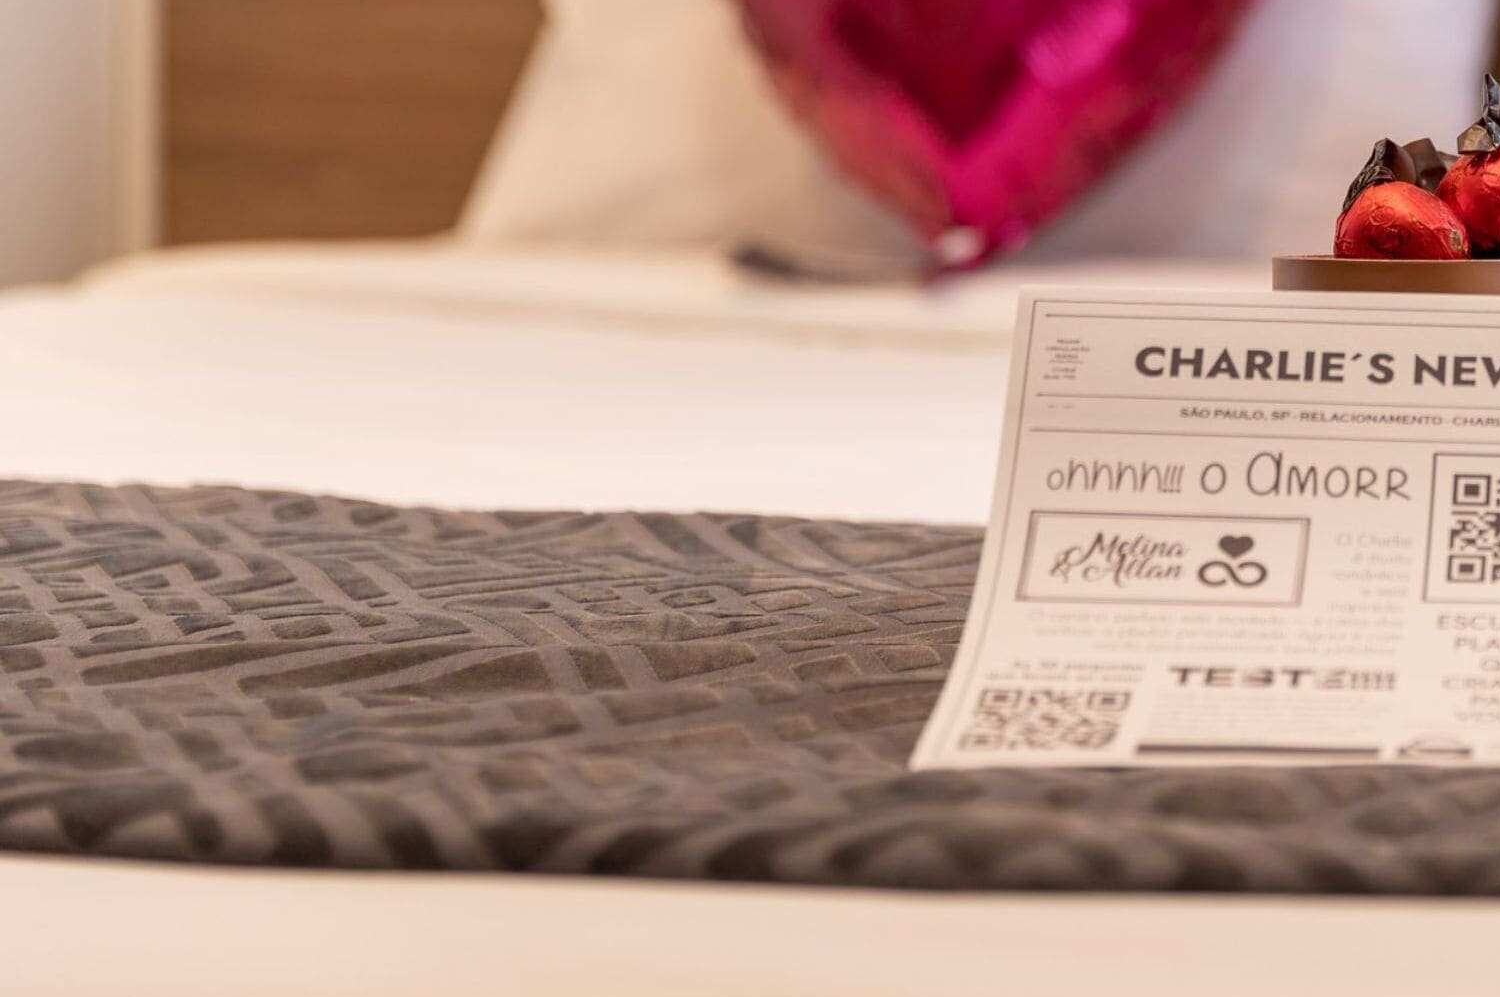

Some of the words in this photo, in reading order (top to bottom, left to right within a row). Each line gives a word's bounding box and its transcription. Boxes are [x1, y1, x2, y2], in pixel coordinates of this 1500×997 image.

[1179, 407, 1210, 419] SÃO
[1271, 411, 1291, 421] SP
[1300, 411, 1443, 426] RELACIONAMENTO
[1063, 532, 1187, 566] Melina
